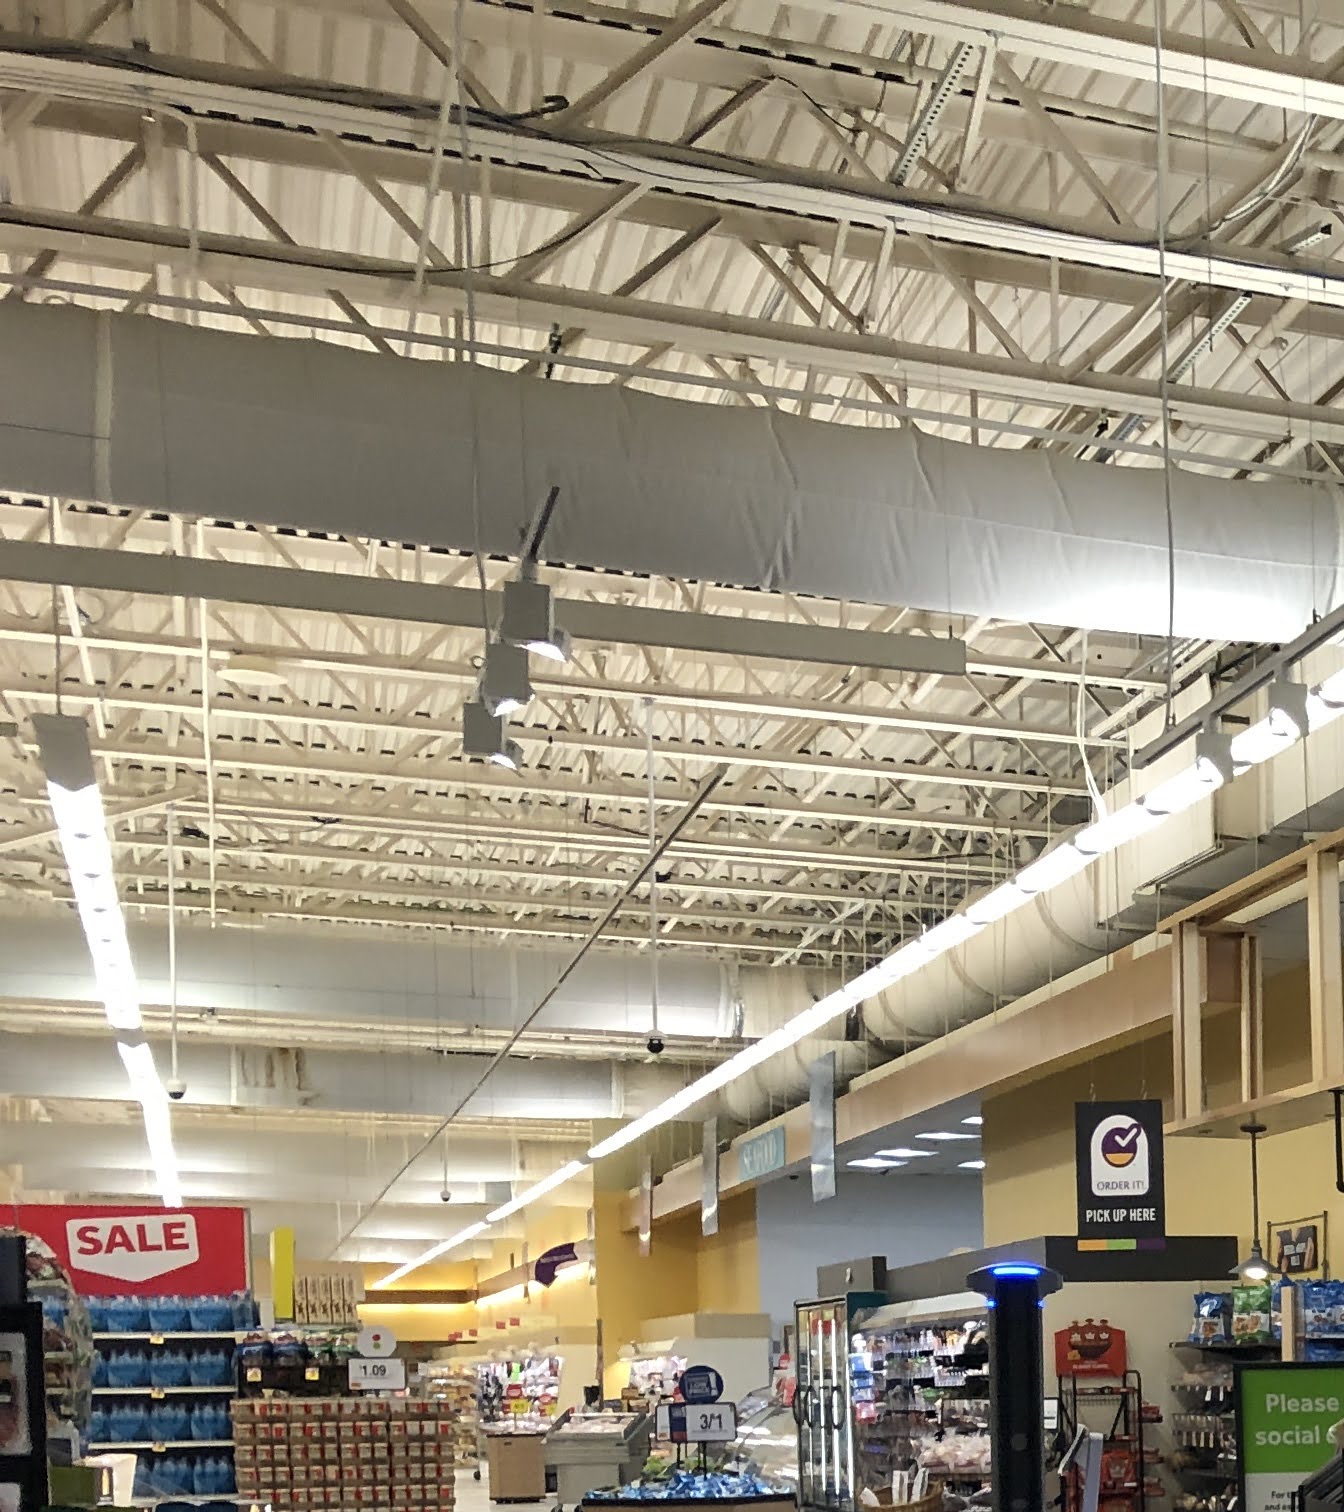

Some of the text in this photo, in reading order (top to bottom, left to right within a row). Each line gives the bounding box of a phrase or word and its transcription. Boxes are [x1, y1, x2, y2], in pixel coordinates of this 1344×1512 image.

[1096, 1181, 1130, 1191] ORDER
[1086, 1207, 1156, 1223] PICK UP HERE
[76, 1220, 190, 1256] SALE
[1265, 1393, 1339, 1413] Please
[1255, 1425, 1320, 1446] social
[1271, 1491, 1285, 1499] For
[1264, 1503, 1281, 1511] and
